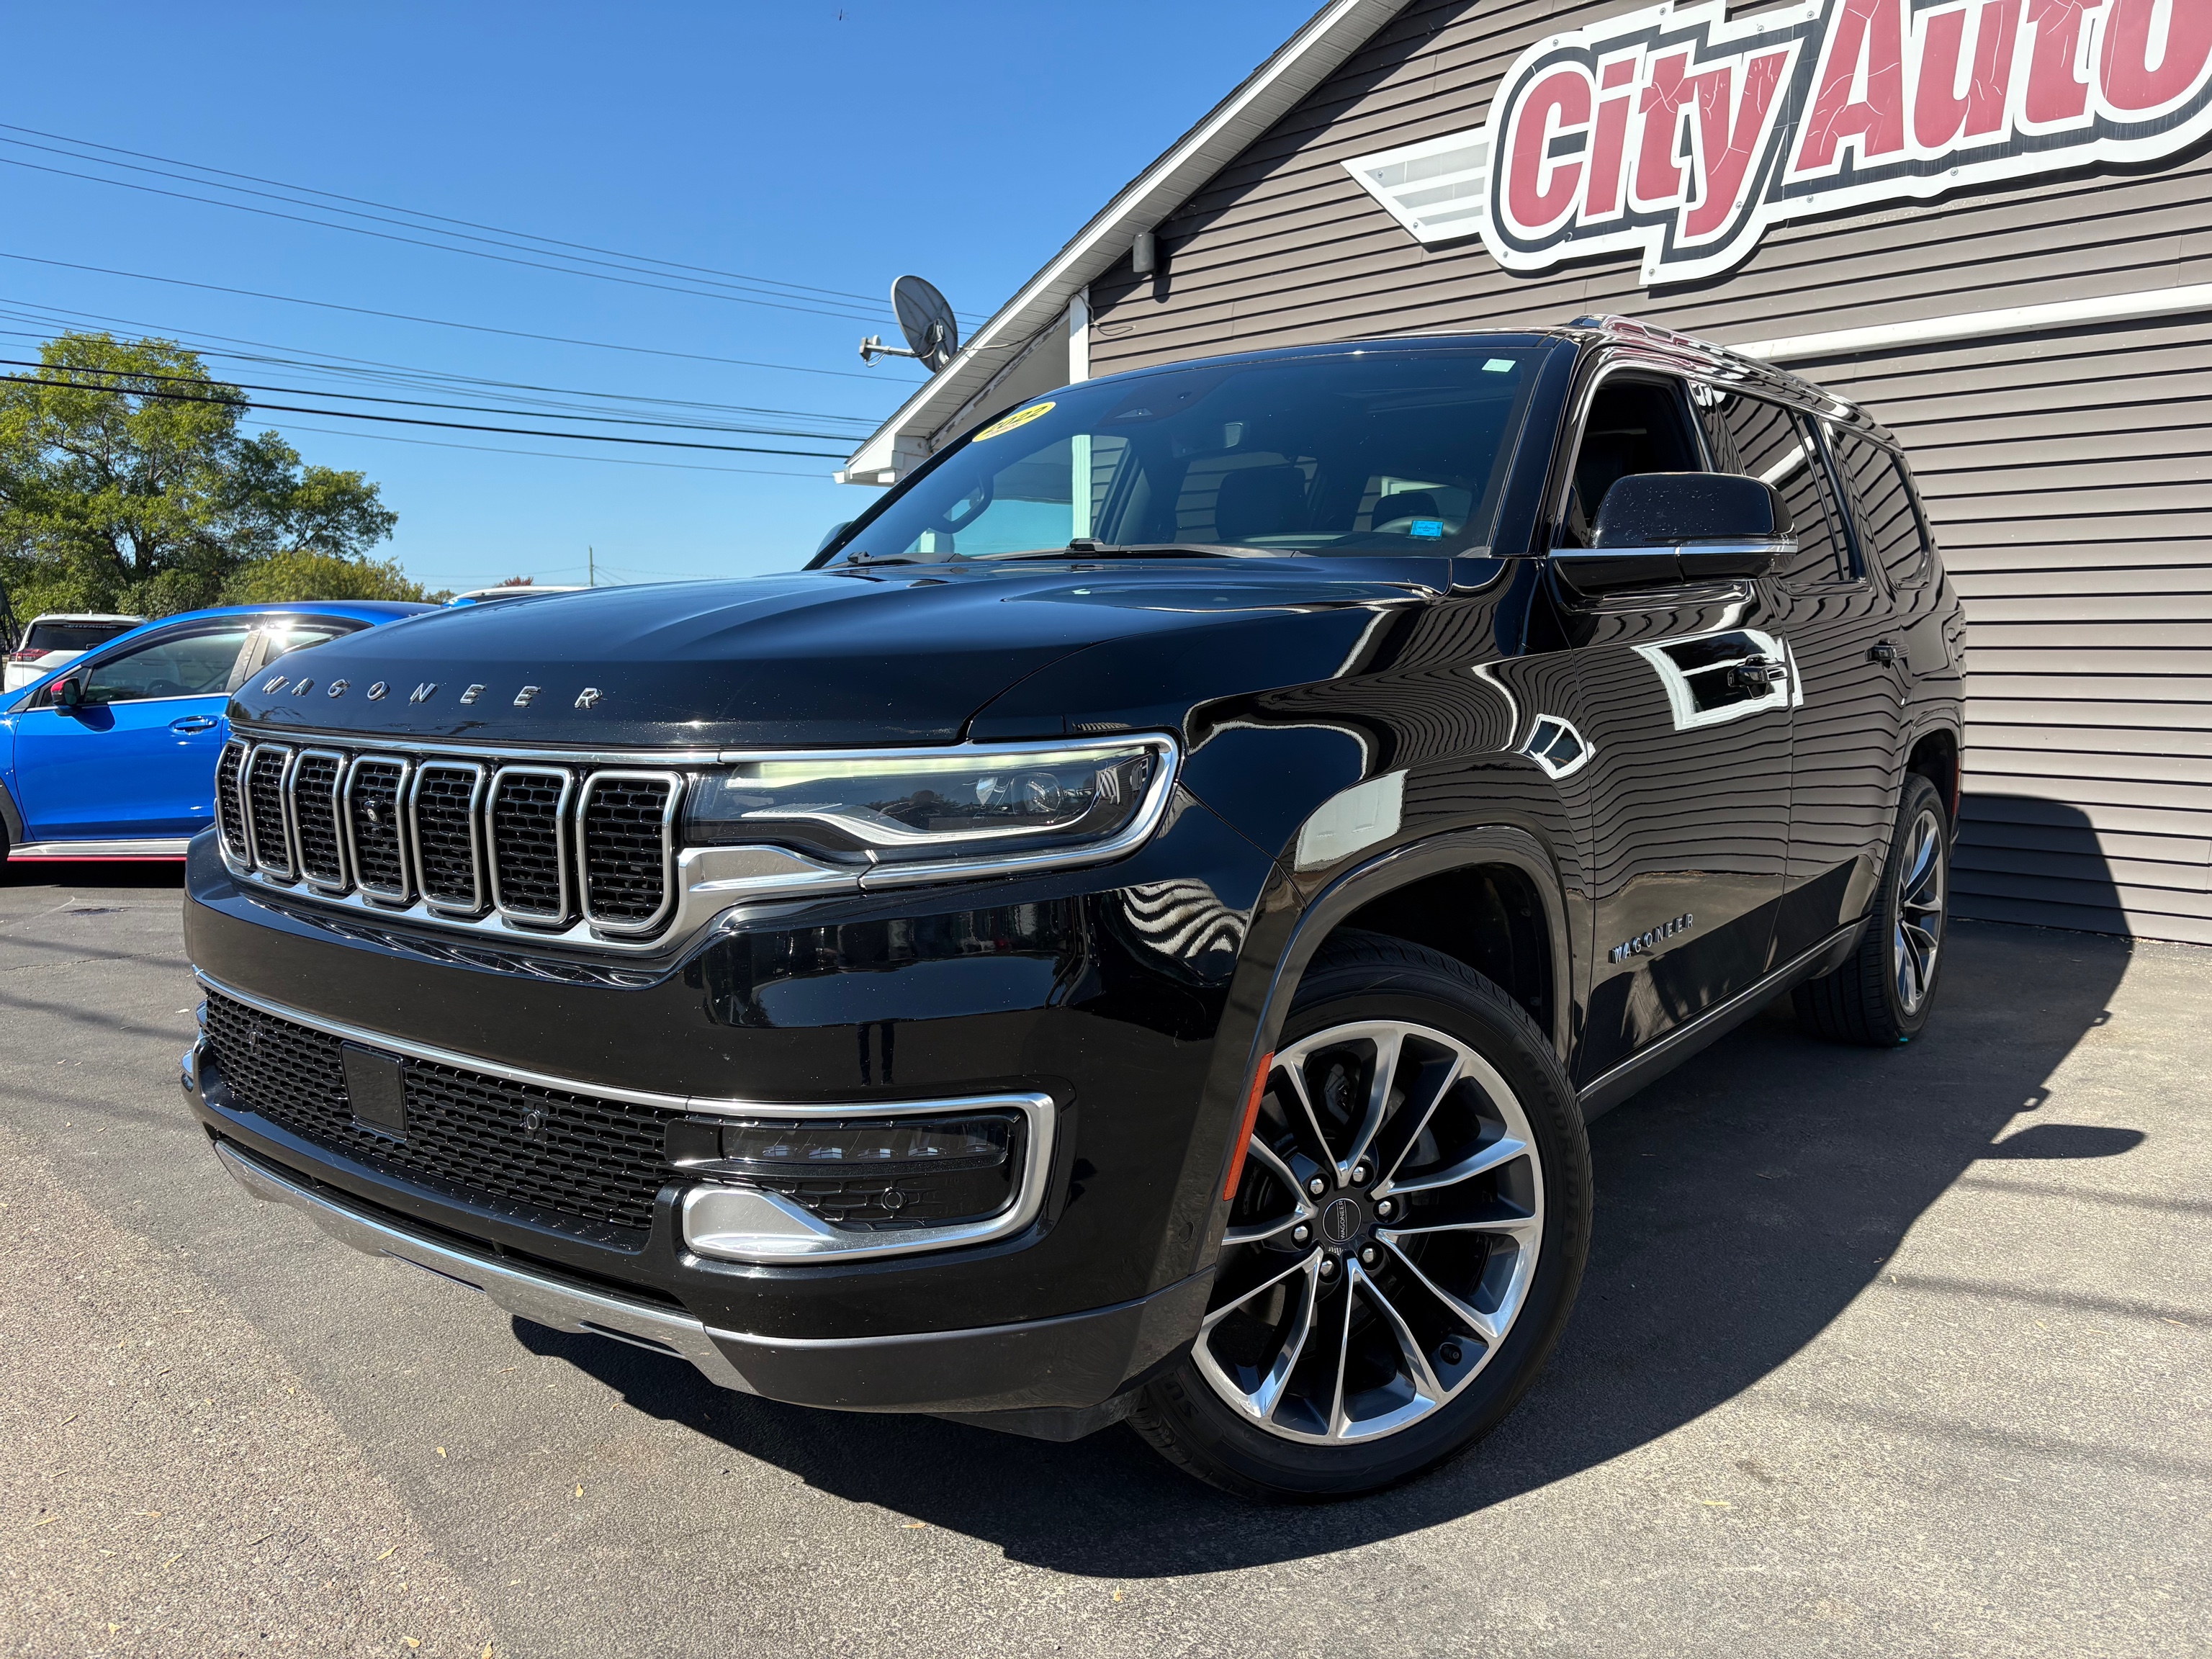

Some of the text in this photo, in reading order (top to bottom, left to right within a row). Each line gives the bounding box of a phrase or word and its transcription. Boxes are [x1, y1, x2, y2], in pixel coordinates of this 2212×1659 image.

[1507, 0, 2212, 239] City Auto
[261, 675, 603, 709] WAGONEER
[1608, 912, 1694, 964] WAGONEER
